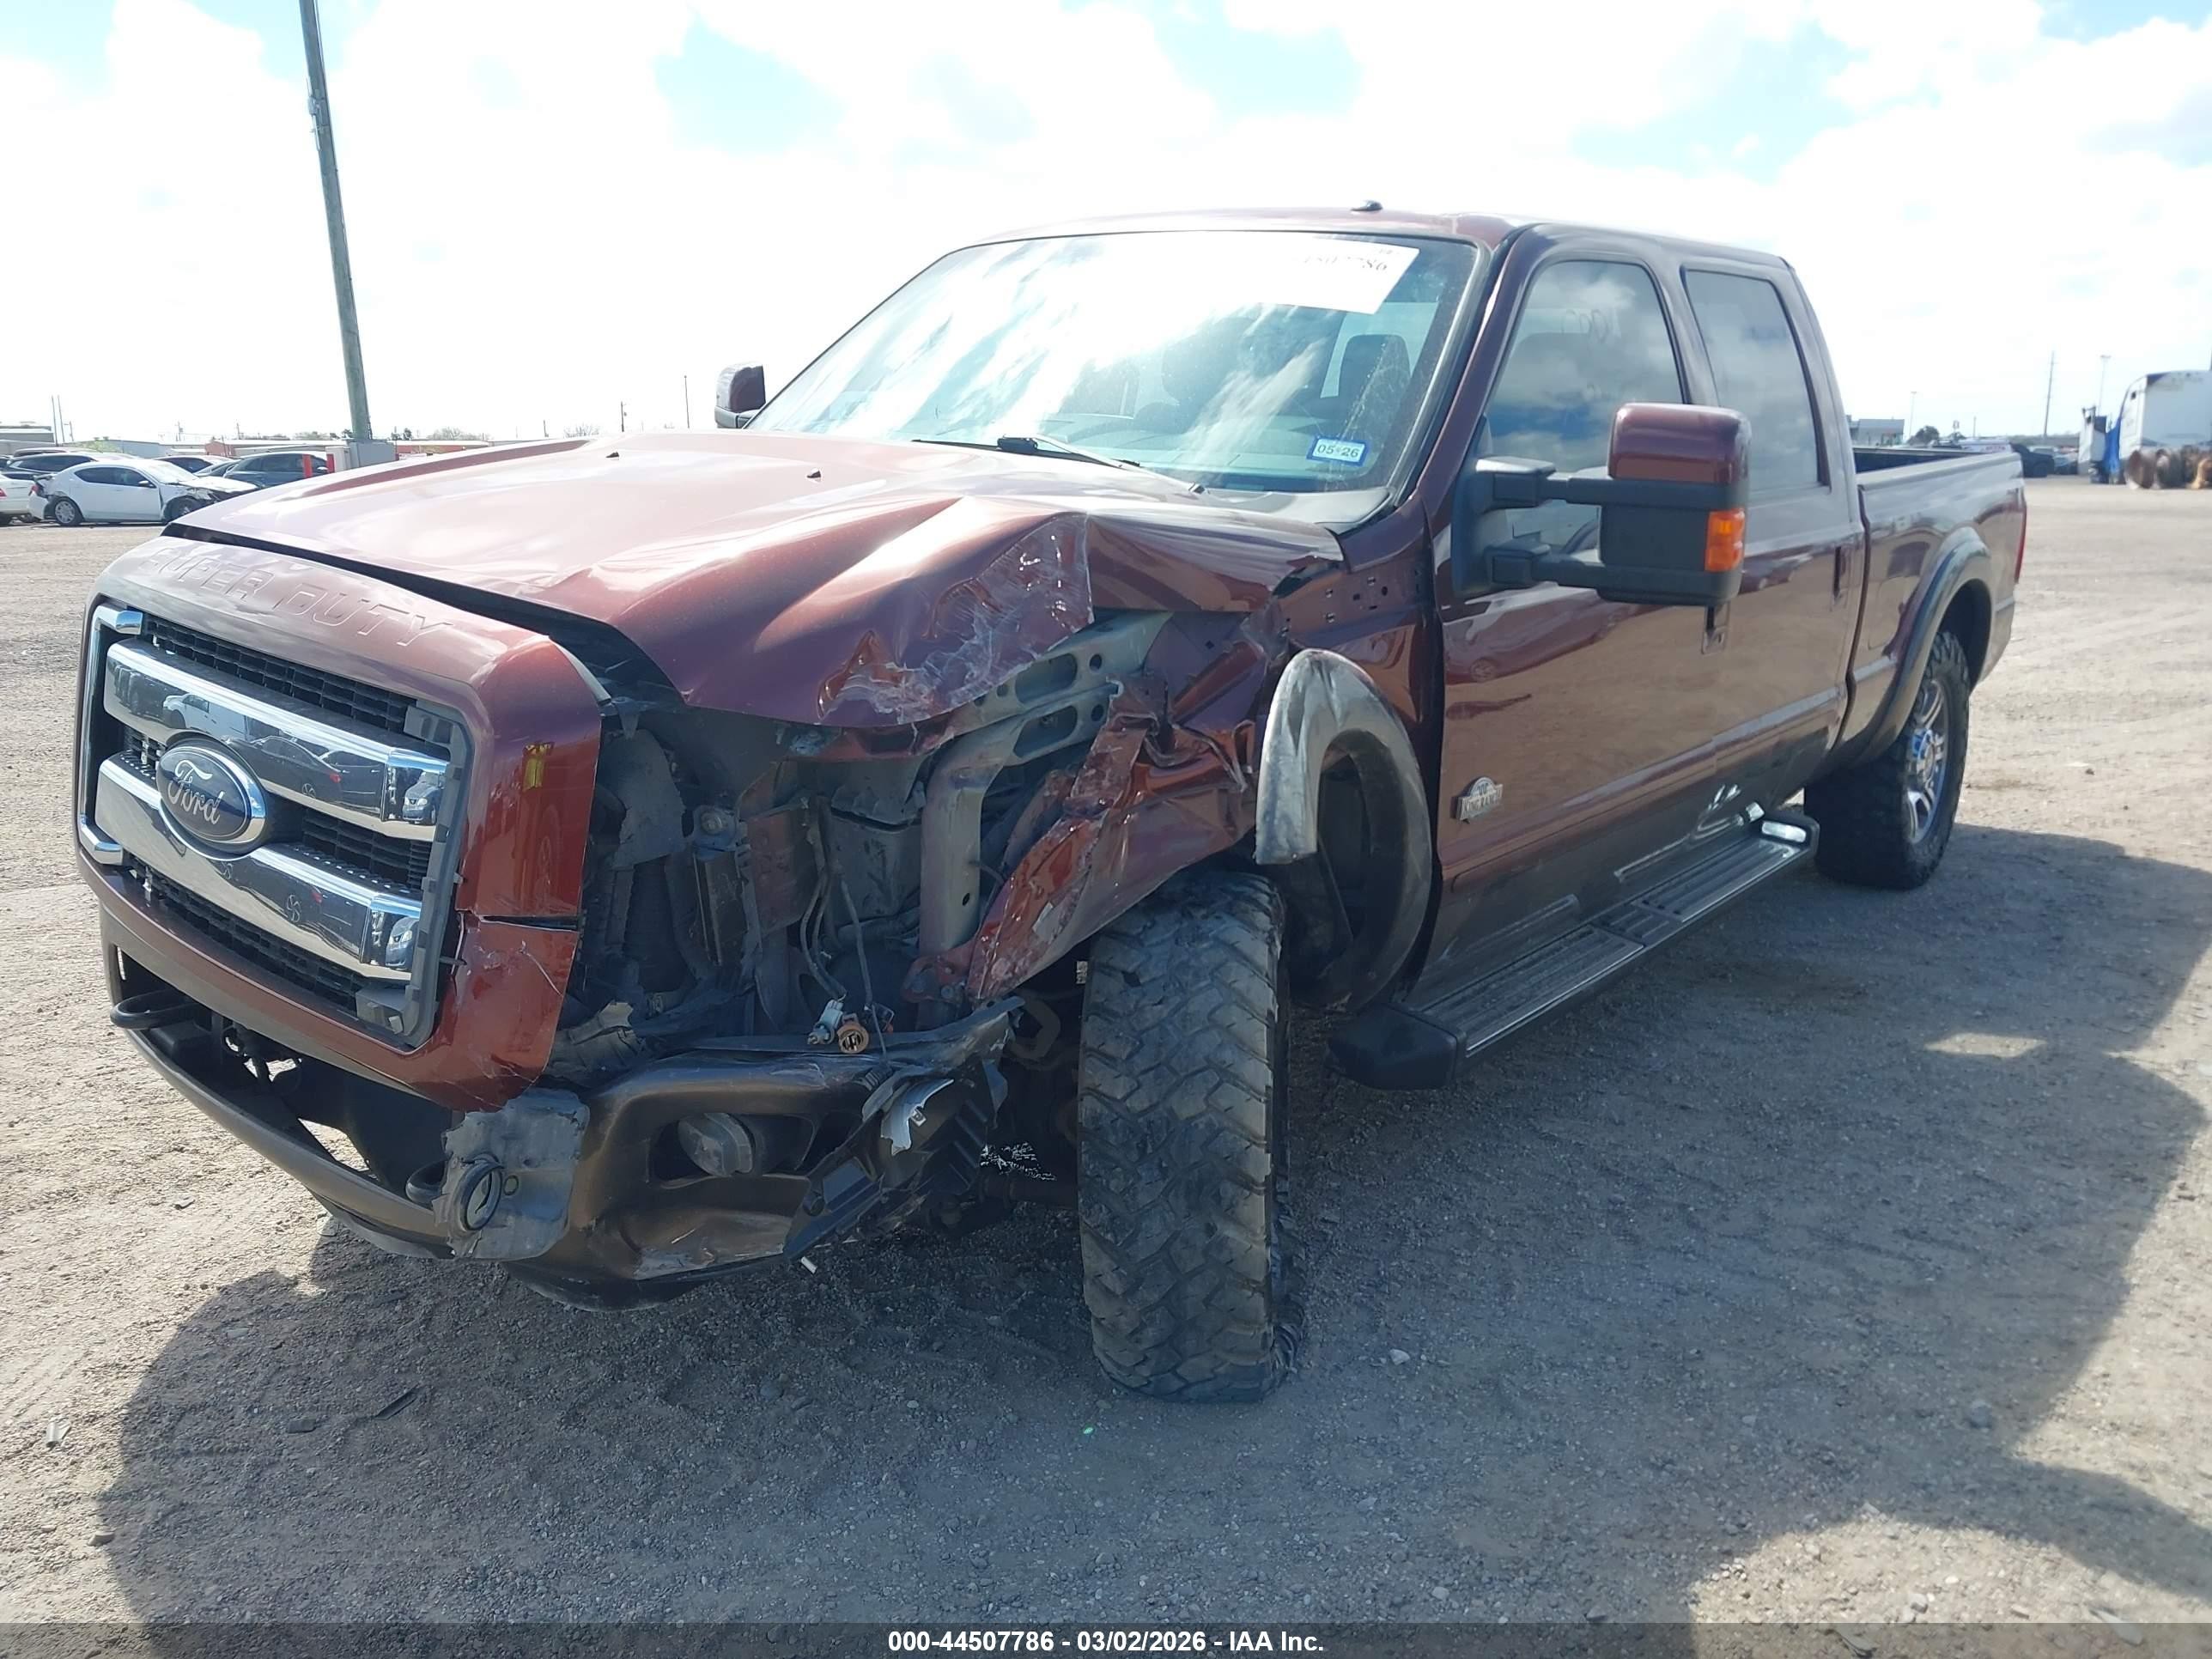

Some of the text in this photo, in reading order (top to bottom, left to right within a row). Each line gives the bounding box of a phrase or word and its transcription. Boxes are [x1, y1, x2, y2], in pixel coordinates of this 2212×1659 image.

[1317, 445, 1360, 459] 05 26
[140, 547, 454, 647] SUPER DUTY
[167, 759, 225, 825] Ford
